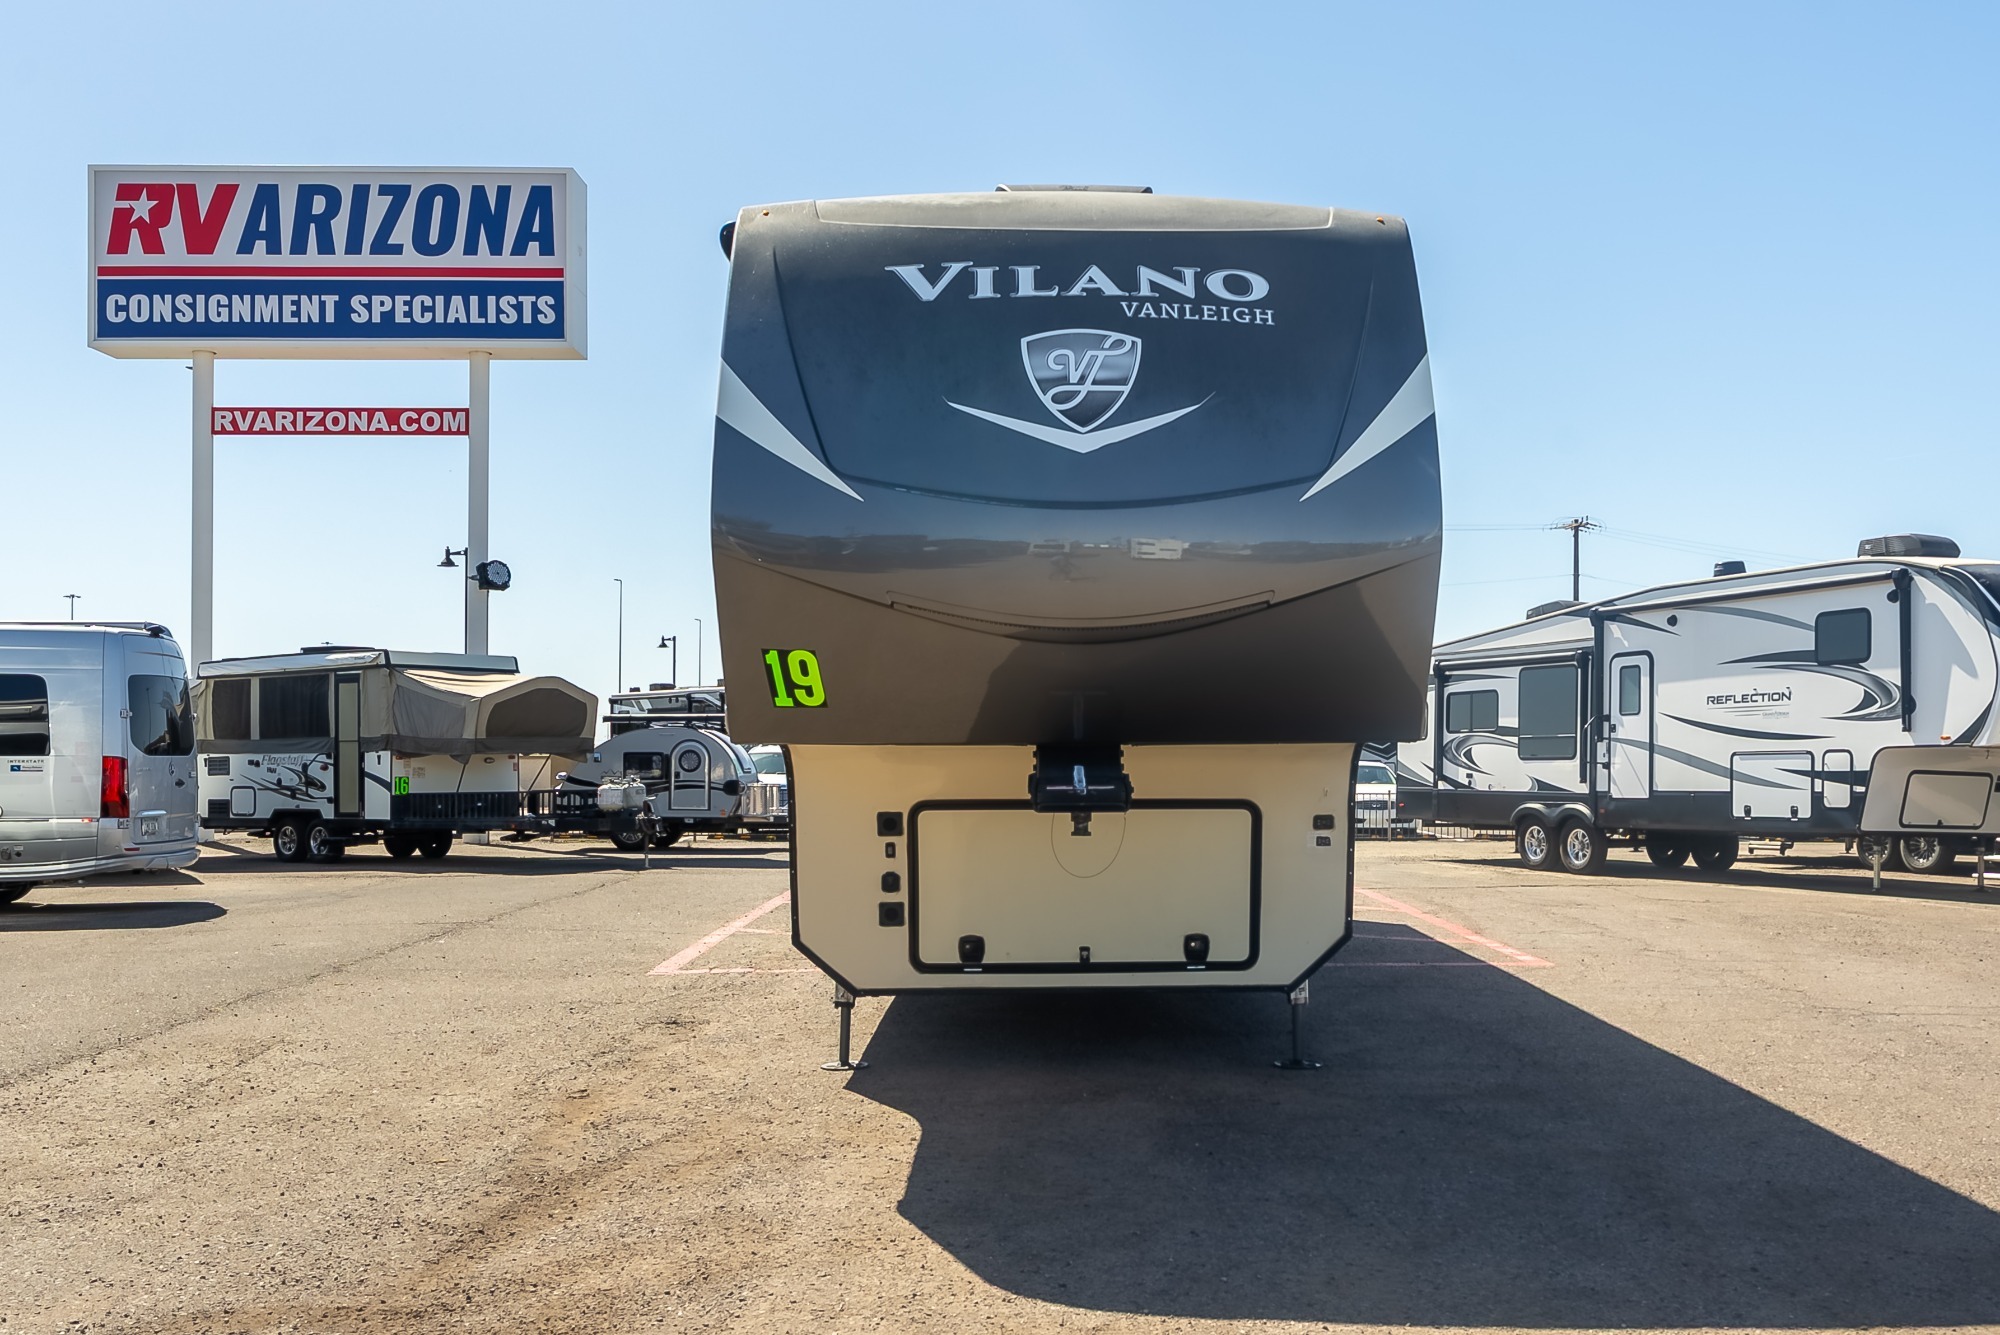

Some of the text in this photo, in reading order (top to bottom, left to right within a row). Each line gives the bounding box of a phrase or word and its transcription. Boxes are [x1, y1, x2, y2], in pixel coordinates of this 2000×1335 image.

[884, 260, 1270, 302] VILANO
[105, 293, 557, 325] CONSIGNMENT SPECIALISTS
[1119, 301, 1275, 326] VANLEIGH
[213, 410, 467, 434] RVARIZONA.COM
[764, 649, 826, 707] 19
[1706, 690, 1792, 706] REFLECTION
[261, 754, 304, 767] Flagstaff
[394, 776, 410, 795] 16
